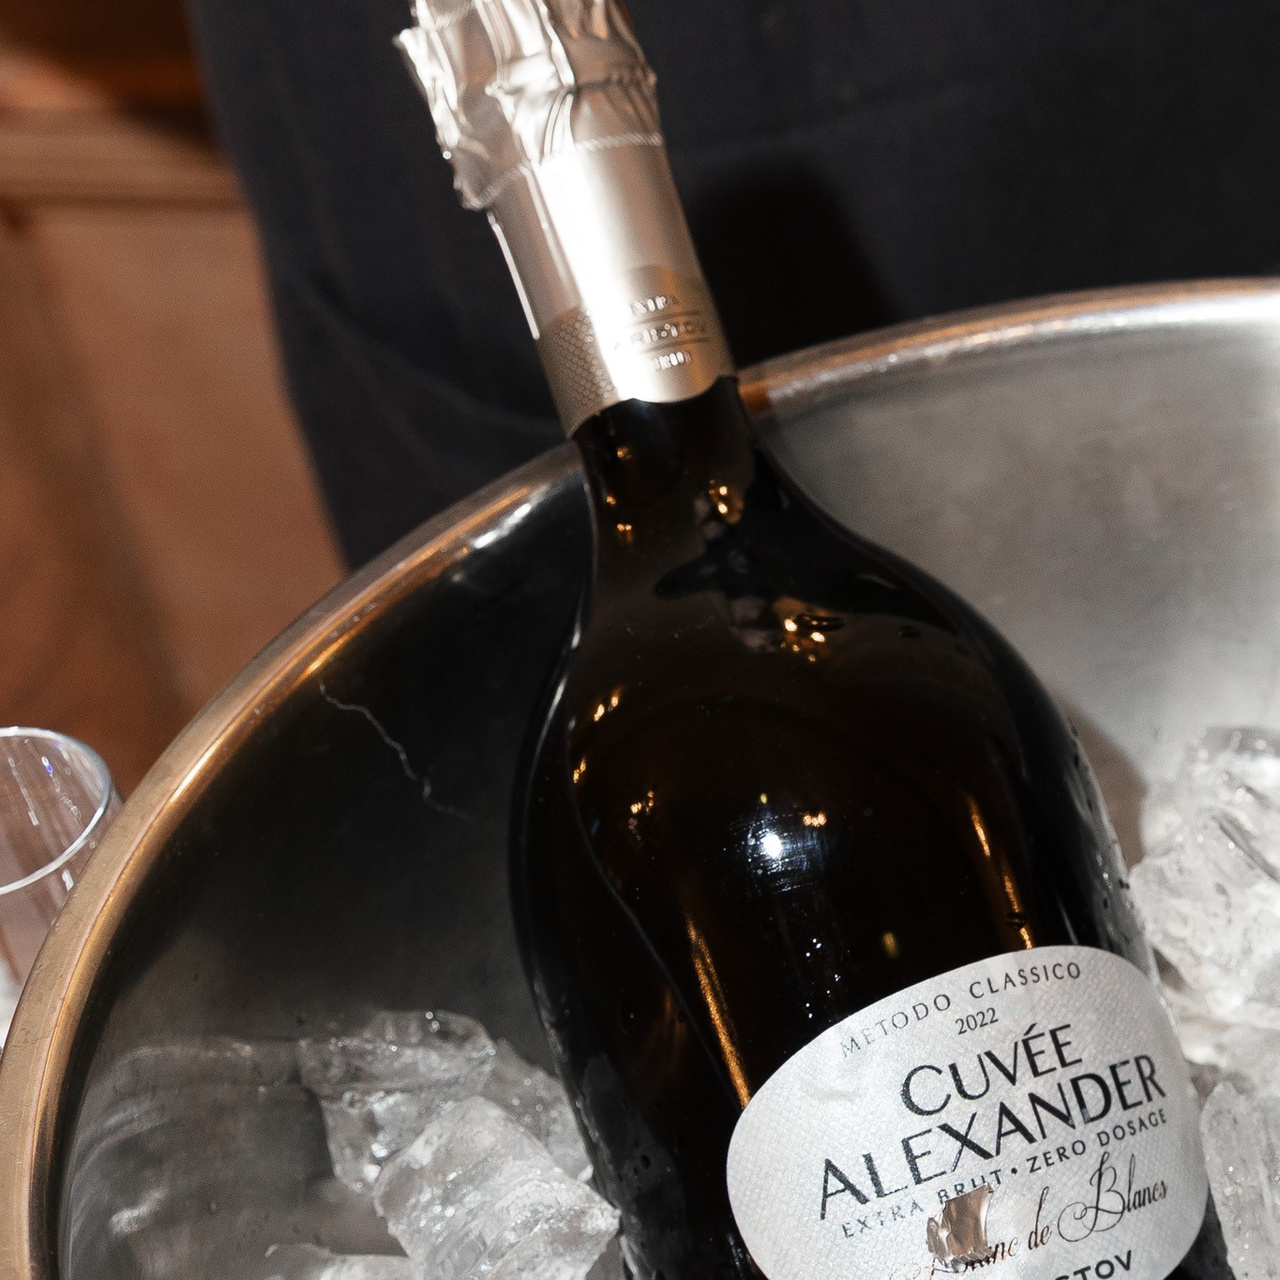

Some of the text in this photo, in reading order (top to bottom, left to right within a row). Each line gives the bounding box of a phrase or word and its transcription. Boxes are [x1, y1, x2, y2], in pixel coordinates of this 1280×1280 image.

[840, 961, 1082, 1059] METODO CLASSICO
[955, 1007, 999, 1035] 2022
[899, 1023, 1084, 1118] CUVÉE
[819, 1054, 1168, 1221] ALEXANDER
[842, 1199, 925, 1239] EXTRA
[1026, 1139, 1088, 1174] ZERO
[1097, 1107, 1168, 1148] DOSAGE
[1027, 1185, 1052, 1251] de
[1057, 1150, 1168, 1243] Blancs
